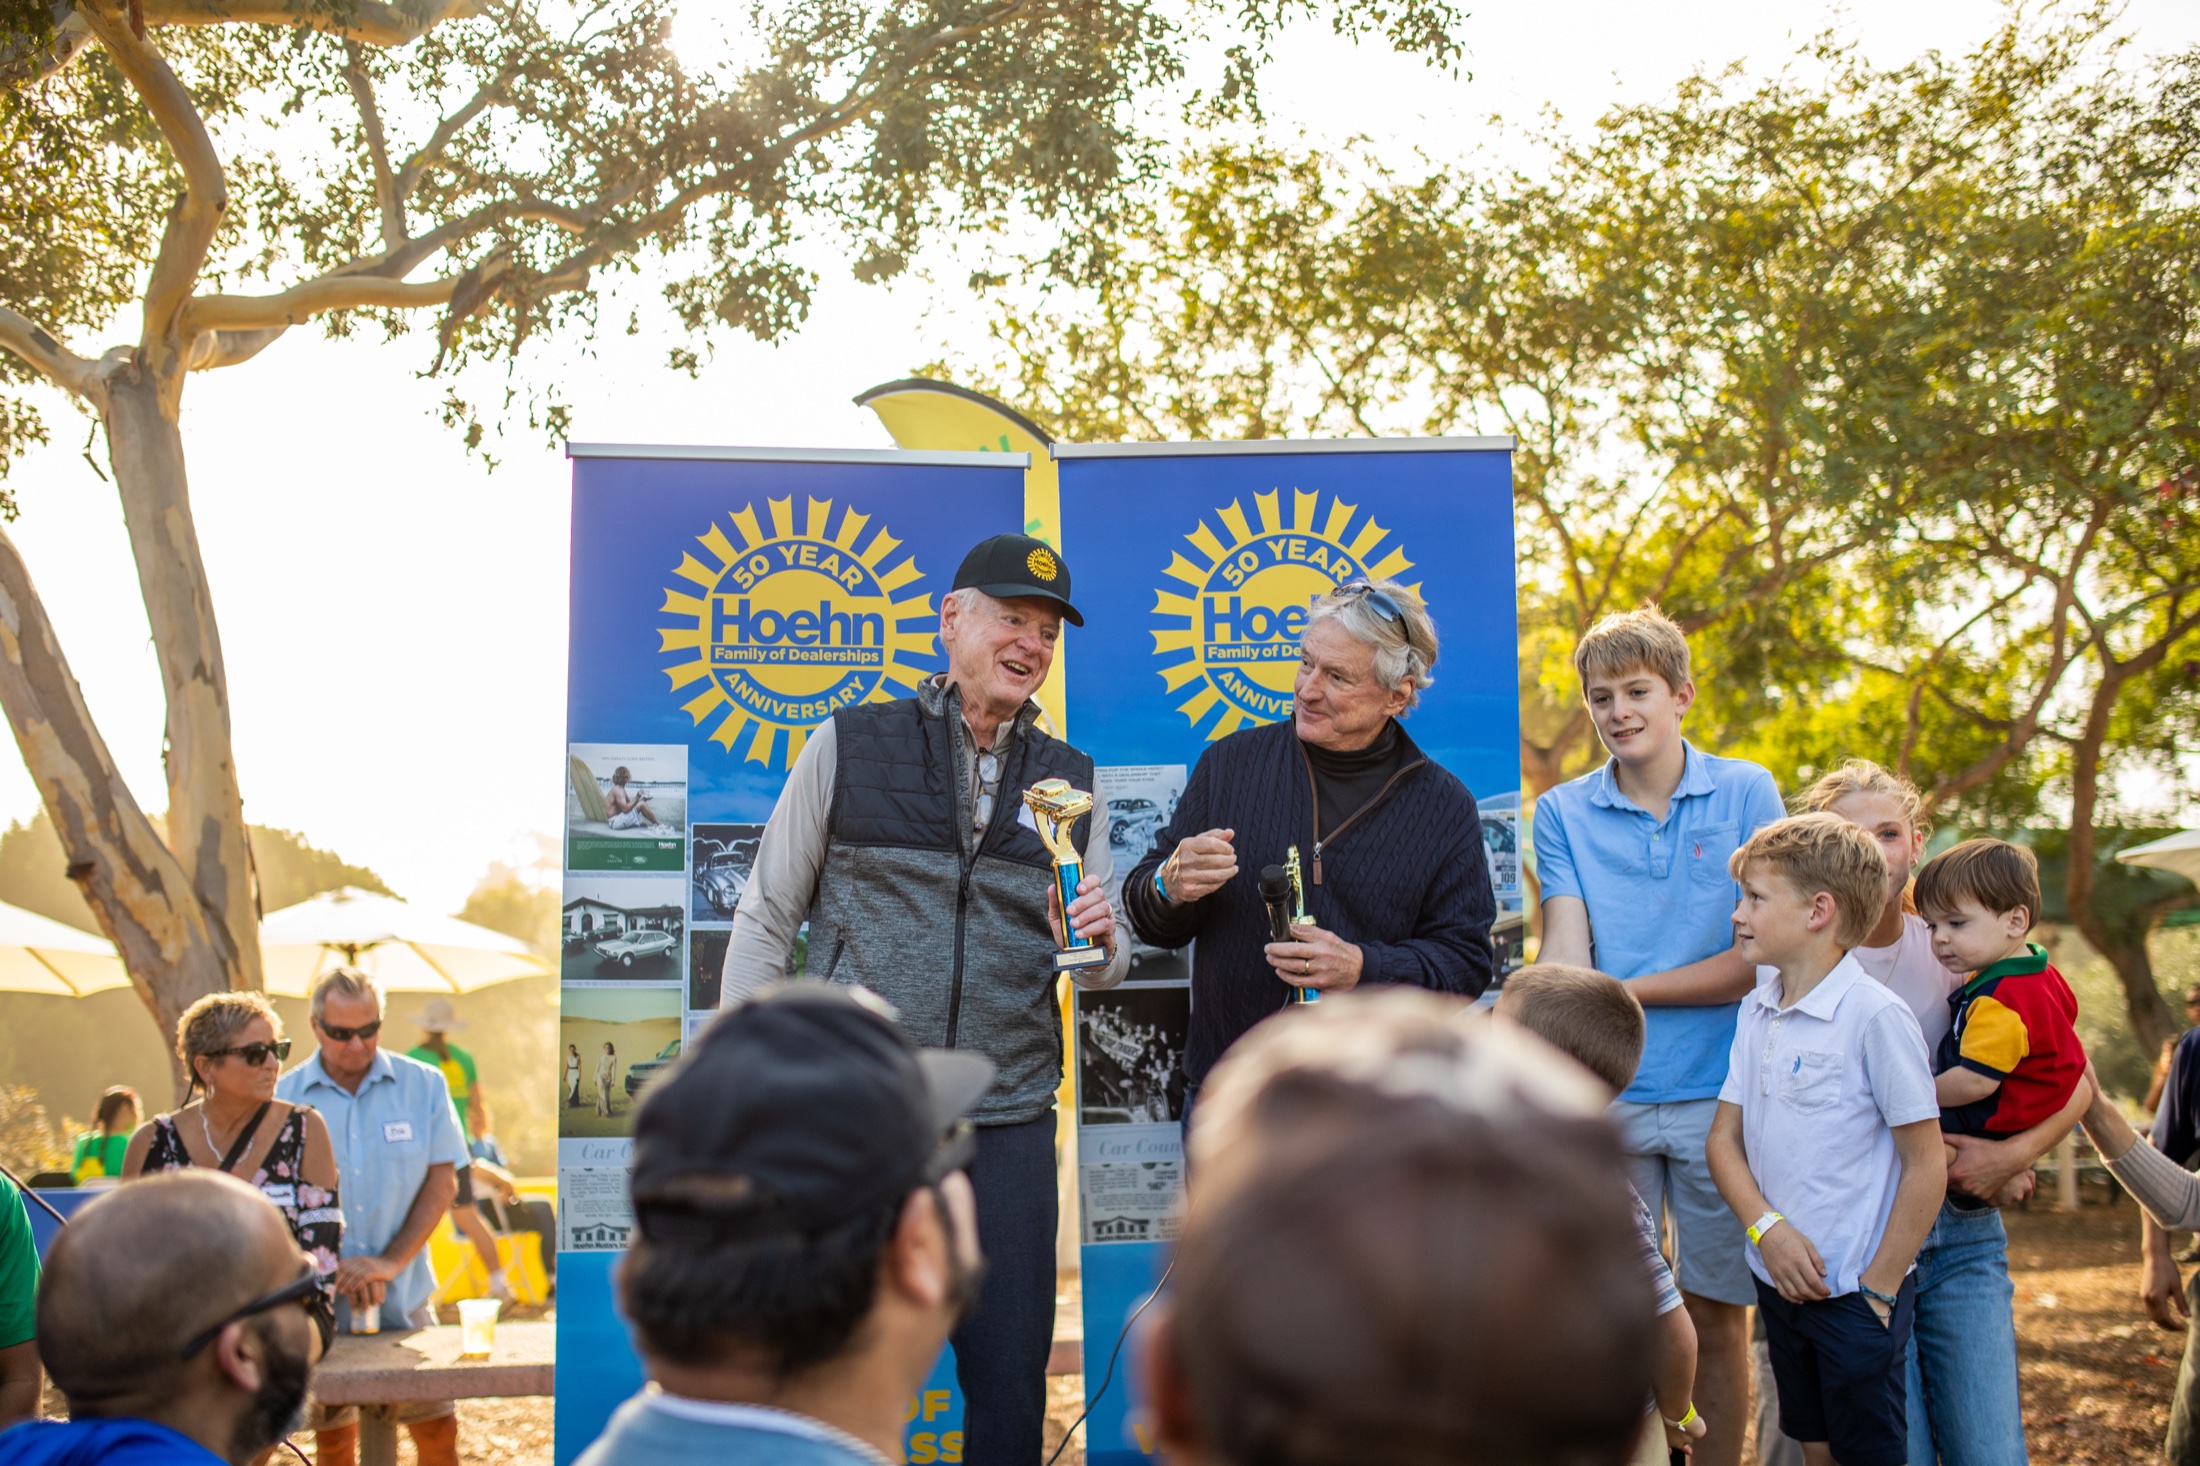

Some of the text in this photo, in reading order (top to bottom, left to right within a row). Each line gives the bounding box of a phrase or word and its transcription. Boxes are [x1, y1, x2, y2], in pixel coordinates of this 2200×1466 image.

[731, 544, 864, 592] 50 YEAR
[1222, 539, 1353, 587] 50 YEAR
[711, 598, 885, 646] Hoehn
[1203, 595, 1311, 643] Hoe
[714, 647, 880, 664] Family of Dealerships
[1207, 645, 1260, 661] Family
[1262, 644, 1279, 658] of
[723, 672, 865, 719] ANNIVERSARY
[1217, 671, 1295, 716] ANNIVE
[1501, 872, 1516, 883] 109
[582, 1143, 615, 1160] Car
[1098, 1137, 1181, 1158] Car Coun
